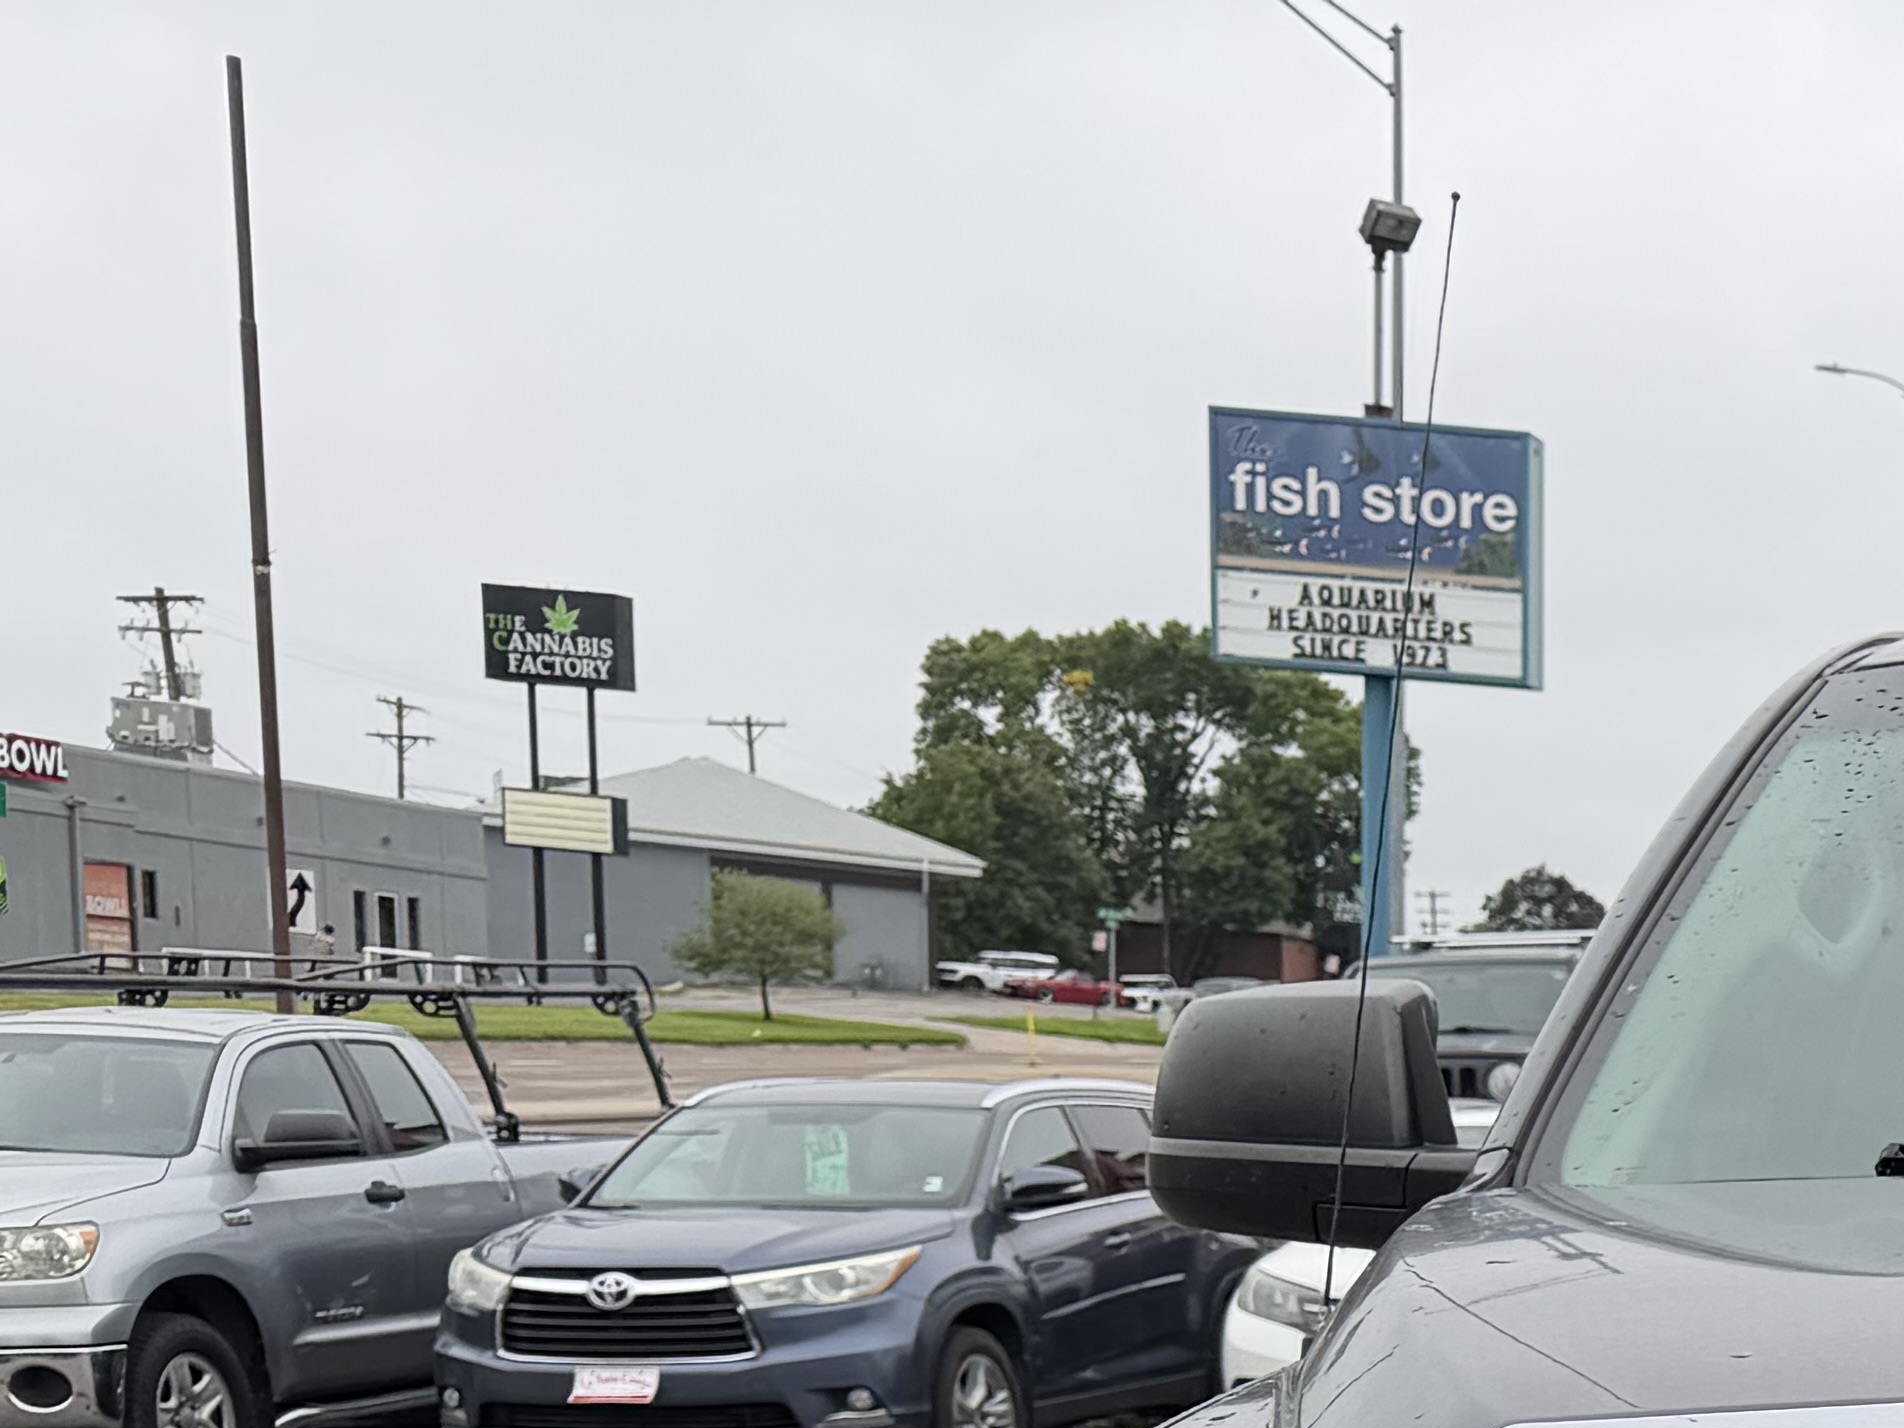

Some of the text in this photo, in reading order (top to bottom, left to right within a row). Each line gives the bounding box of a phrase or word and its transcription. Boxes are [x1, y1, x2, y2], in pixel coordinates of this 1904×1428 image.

[1228, 461, 1518, 532] fish store
[1298, 583, 1436, 616] AQUARIUM
[486, 613, 526, 631] THE
[1267, 606, 1473, 645] HEADQUARTERS
[493, 631, 613, 658] CANNABIS
[1292, 635, 1448, 670] SINCE 1973
[508, 652, 611, 680] FACTORY
